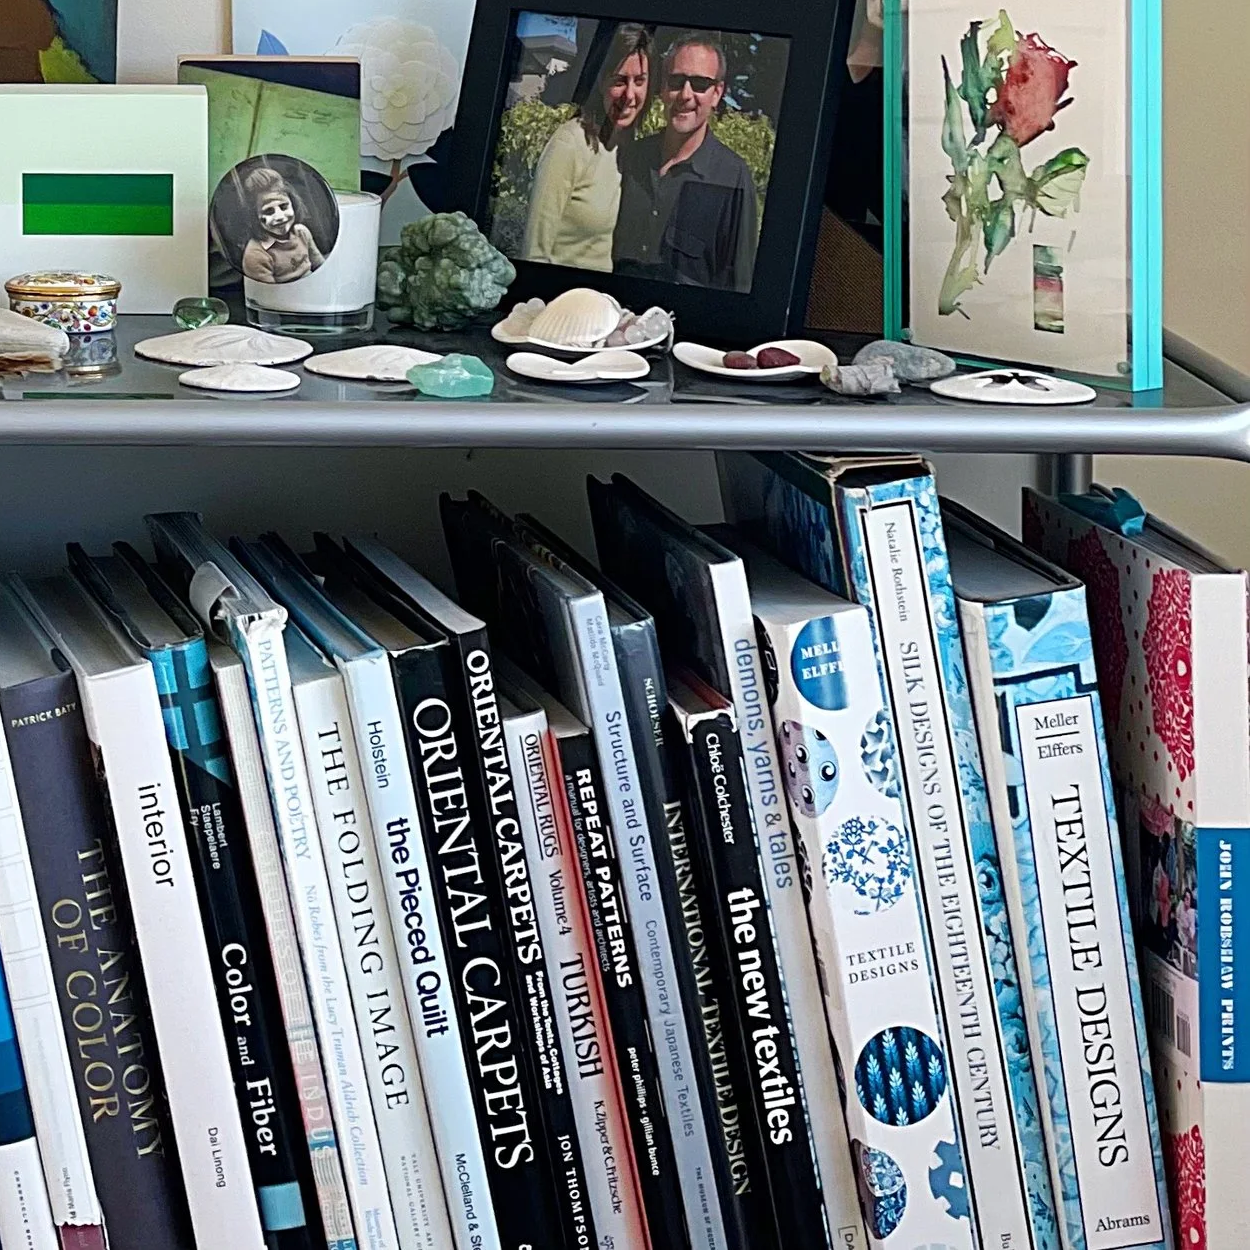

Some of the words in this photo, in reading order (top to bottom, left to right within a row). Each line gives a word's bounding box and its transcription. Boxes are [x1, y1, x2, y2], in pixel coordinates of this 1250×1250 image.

[885, 522, 899, 564] Natalie
[892, 567, 908, 622] Rothstein
[734, 638, 765, 737] demons,
[900, 643, 920, 694] SILK
[11, 710, 53, 728] PATRICK
[55, 702, 77, 719] BATY
[258, 638, 287, 735] PATTERNS
[276, 738, 295, 782] AND
[1034, 713, 1079, 731] Meller
[318, 721, 350, 796] THE
[366, 720, 390, 789] Holstein
[524, 733, 549, 812] ORIENTAL
[605, 711, 632, 793] Structure
[748, 739, 778, 806] yarns
[909, 702, 939, 795] DESIGNS
[1036, 740, 1083, 760] Elffers
[138, 783, 174, 887] interior
[212, 803, 228, 848] Lambert
[386, 817, 409, 864] the
[466, 649, 513, 816] ORIENTAL
[495, 817, 542, 965] CARPETS
[539, 813, 561, 858] RUGS
[622, 799, 639, 829] and
[713, 774, 735, 845] Colchester
[764, 812, 782, 827] &
[928, 804, 948, 832] OF
[333, 809, 385, 975] FOLDING
[576, 768, 608, 859] REPEAT
[595, 865, 633, 988] PATTERNS
[629, 834, 652, 902] Surface
[768, 831, 793, 889] tales
[933, 837, 958, 887] THE
[1051, 784, 1103, 972] TEXTILE
[1219, 839, 1232, 890] JOHN
[52, 898, 88, 953] OF
[396, 868, 436, 965] Pieced
[549, 869, 568, 925] Volume
[559, 925, 572, 936] 4
[727, 885, 761, 946] the
[413, 697, 492, 948] ORIENTAL
[462, 956, 534, 1170] CARPETS
[846, 941, 916, 968] TEXTILE
[946, 892, 981, 1042] EIGHTEENTH
[1220, 898, 1233, 991] ROBSHAW
[77, 838, 117, 931] THE
[97, 947, 165, 1159] ANATOMY
[221, 942, 253, 1026] Color
[645, 919, 671, 1016] Contemporary
[662, 801, 713, 996] INTERNATIONAL
[701, 998, 734, 1102] TEXTILE
[718, 1102, 751, 1196] DESIGN
[738, 950, 772, 1020] new
[848, 958, 920, 985] DESIGNS
[416, 970, 450, 1038] Quilt
[560, 951, 604, 1081] TURKISH
[1221, 999, 1234, 1071] PRINTS
[66, 969, 121, 1123] COLOR
[238, 1036, 255, 1066] and
[366, 988, 410, 1110] IMAGE
[627, 1046, 640, 1073] peter
[664, 1019, 685, 1081] Japanese
[1076, 982, 1129, 1168] DESIGNS
[246, 1077, 277, 1157] Fiber
[632, 1073, 647, 1111] phillips
[677, 1084, 695, 1137] Textiles
[752, 1024, 796, 1146] textiles
[965, 1048, 1001, 1151] CENTURY
[208, 1127, 219, 1145] Dai
[557, 1134, 574, 1163] JON
[640, 1116, 655, 1146] gillian
[649, 1146, 660, 1176] bunce
[212, 1146, 226, 1188] Linong
[455, 1152, 478, 1221] McClelland
[1095, 1213, 1151, 1234] Abrams
